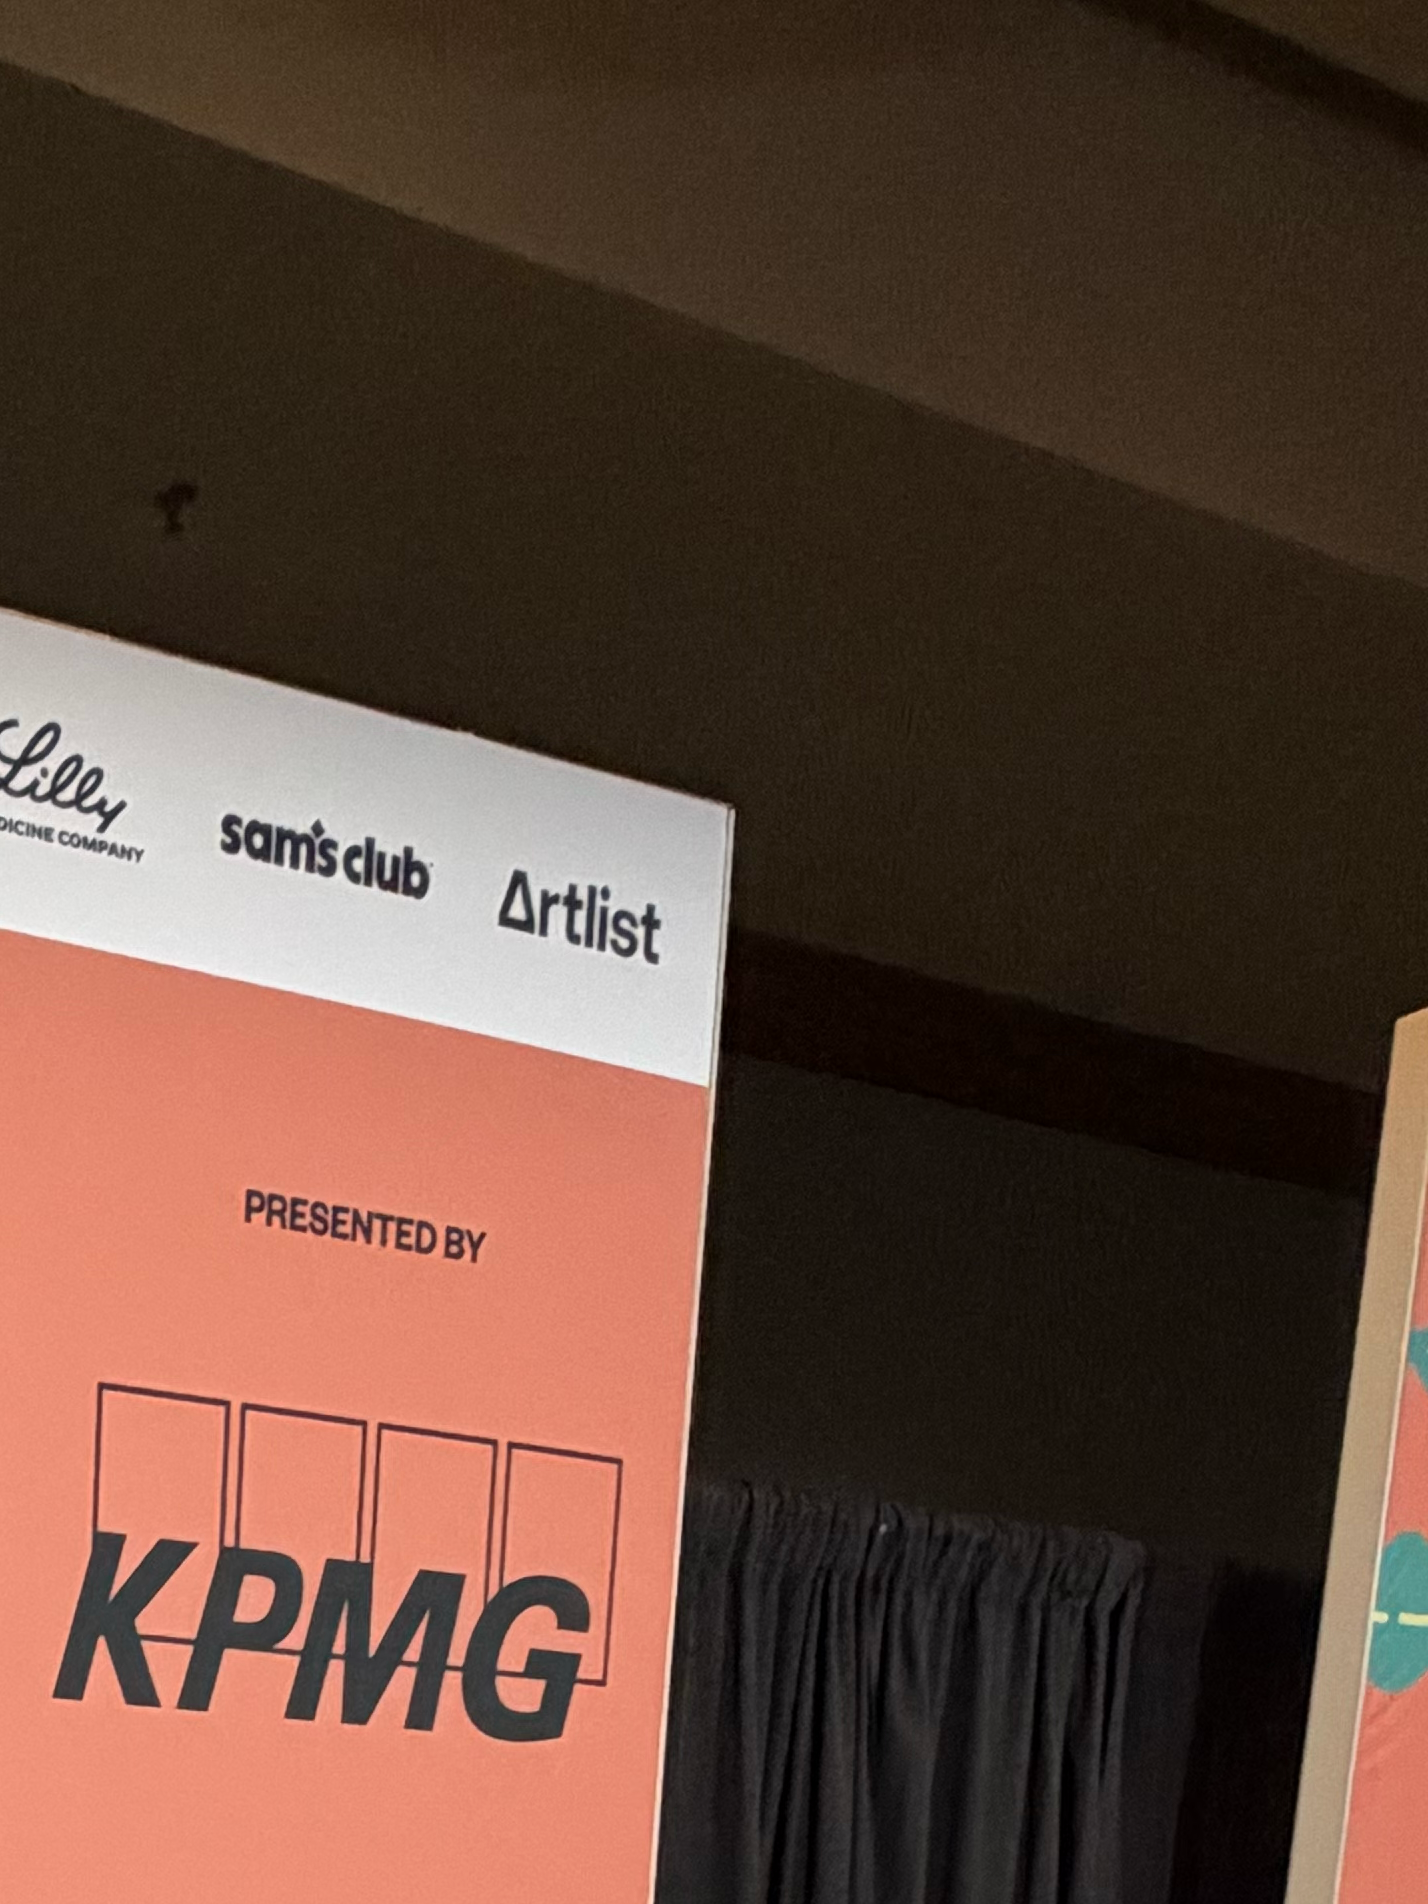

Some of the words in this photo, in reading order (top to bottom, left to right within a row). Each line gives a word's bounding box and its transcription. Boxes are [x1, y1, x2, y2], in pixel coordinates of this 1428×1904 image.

[57, 830, 145, 863] COMPANY
[220, 813, 338, 878] sam's
[343, 837, 430, 900] club
[499, 869, 662, 965] Artlist
[244, 1188, 438, 1255] PRESENTED
[443, 1225, 487, 1264] BY
[53, 1530, 591, 1742] KPMG
